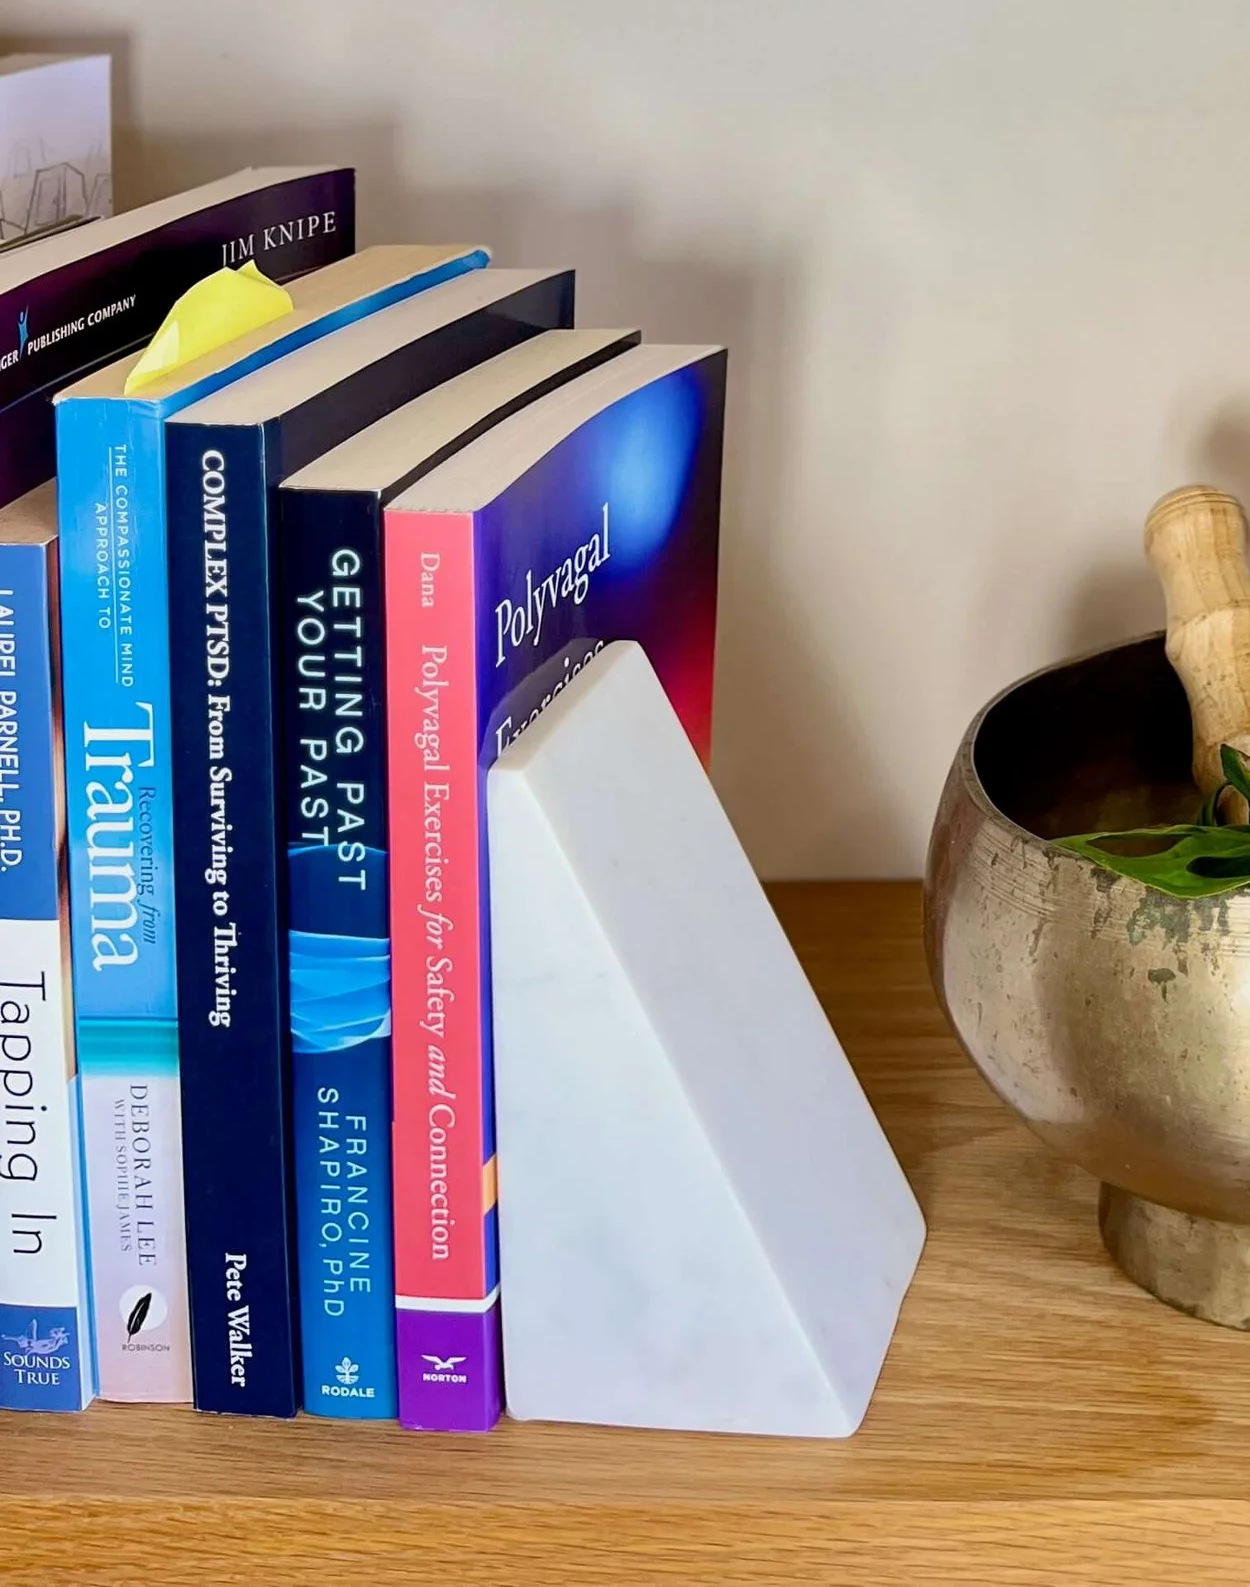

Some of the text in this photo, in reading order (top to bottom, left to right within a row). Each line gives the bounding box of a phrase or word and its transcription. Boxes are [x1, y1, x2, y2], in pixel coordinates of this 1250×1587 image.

[221, 211, 337, 266] JIM KNIPE
[27, 318, 85, 355] PUBLISHING
[87, 294, 137, 327] COMPANY
[95, 502, 111, 629] APPROACH TO
[115, 444, 134, 688] THE COMPASSIONATE MIND
[420, 551, 441, 608] Dana
[495, 502, 611, 668] Polyvagal
[201, 449, 238, 1028] COMPLEX PTSD: From Surviving to Thriving
[297, 590, 329, 847] YOUR PAST
[331, 549, 366, 891] GETTING PAST
[0, 810, 22, 872] PH.D.
[83, 701, 155, 972] Trauma
[136, 786, 161, 945] Recovering from
[414, 643, 456, 1262] Polyvagal Exercises for Safety and Connection
[0, 970, 58, 1256] Tapping In
[114, 1098, 132, 1252] WITH SOPHIE JAMES
[130, 1084, 157, 1266] DEBORAH LEE
[317, 1087, 344, 1317] SHAPIRO, PhD
[345, 1114, 371, 1293] FRANCINE
[3, 1351, 71, 1370] SOUNDS
[13, 1368, 60, 1385] TRUE
[122, 1343, 171, 1353] ROBINSON
[225, 1252, 253, 1388] Pete Walker
[321, 1385, 376, 1398] RODALE
[422, 1373, 467, 1383] NORTON
